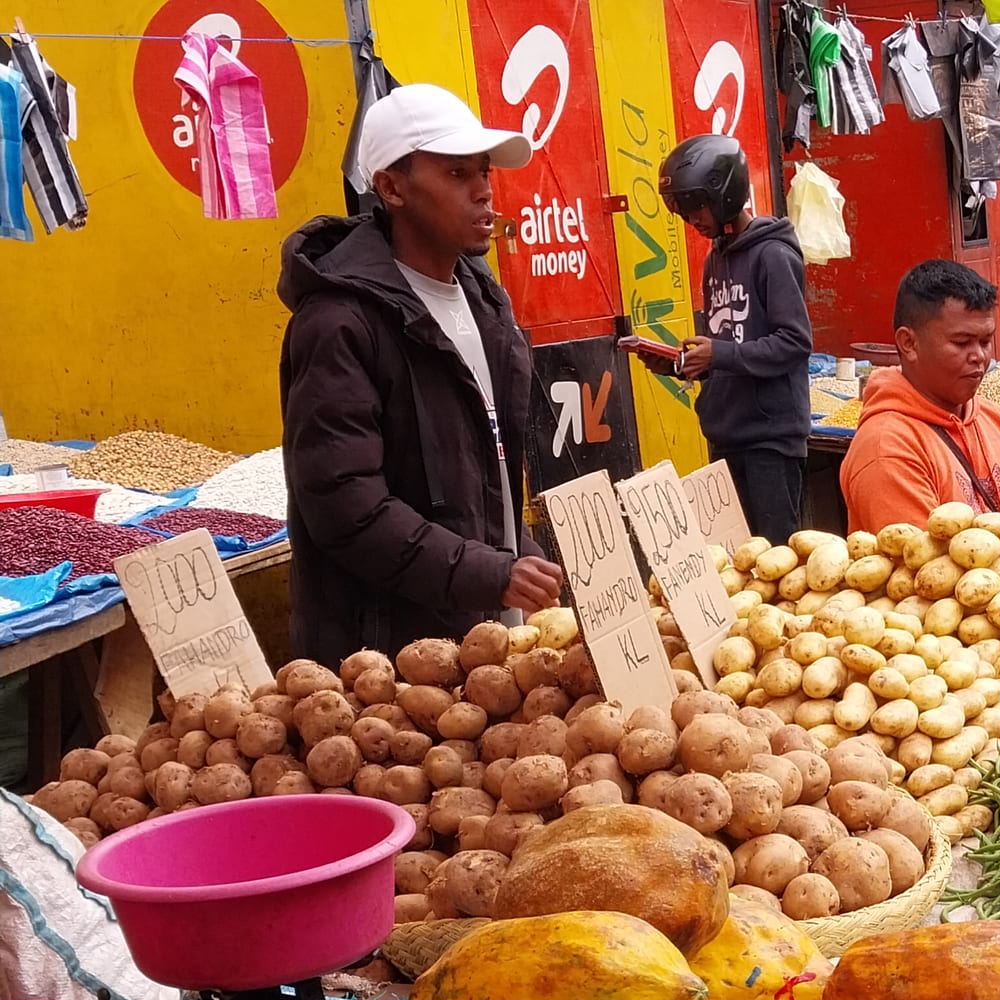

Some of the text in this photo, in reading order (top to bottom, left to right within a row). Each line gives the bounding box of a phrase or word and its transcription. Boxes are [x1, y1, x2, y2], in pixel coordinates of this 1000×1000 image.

[520, 192, 589, 245] airtel
[531, 248, 586, 280] money
[616, 628, 650, 672] KL
